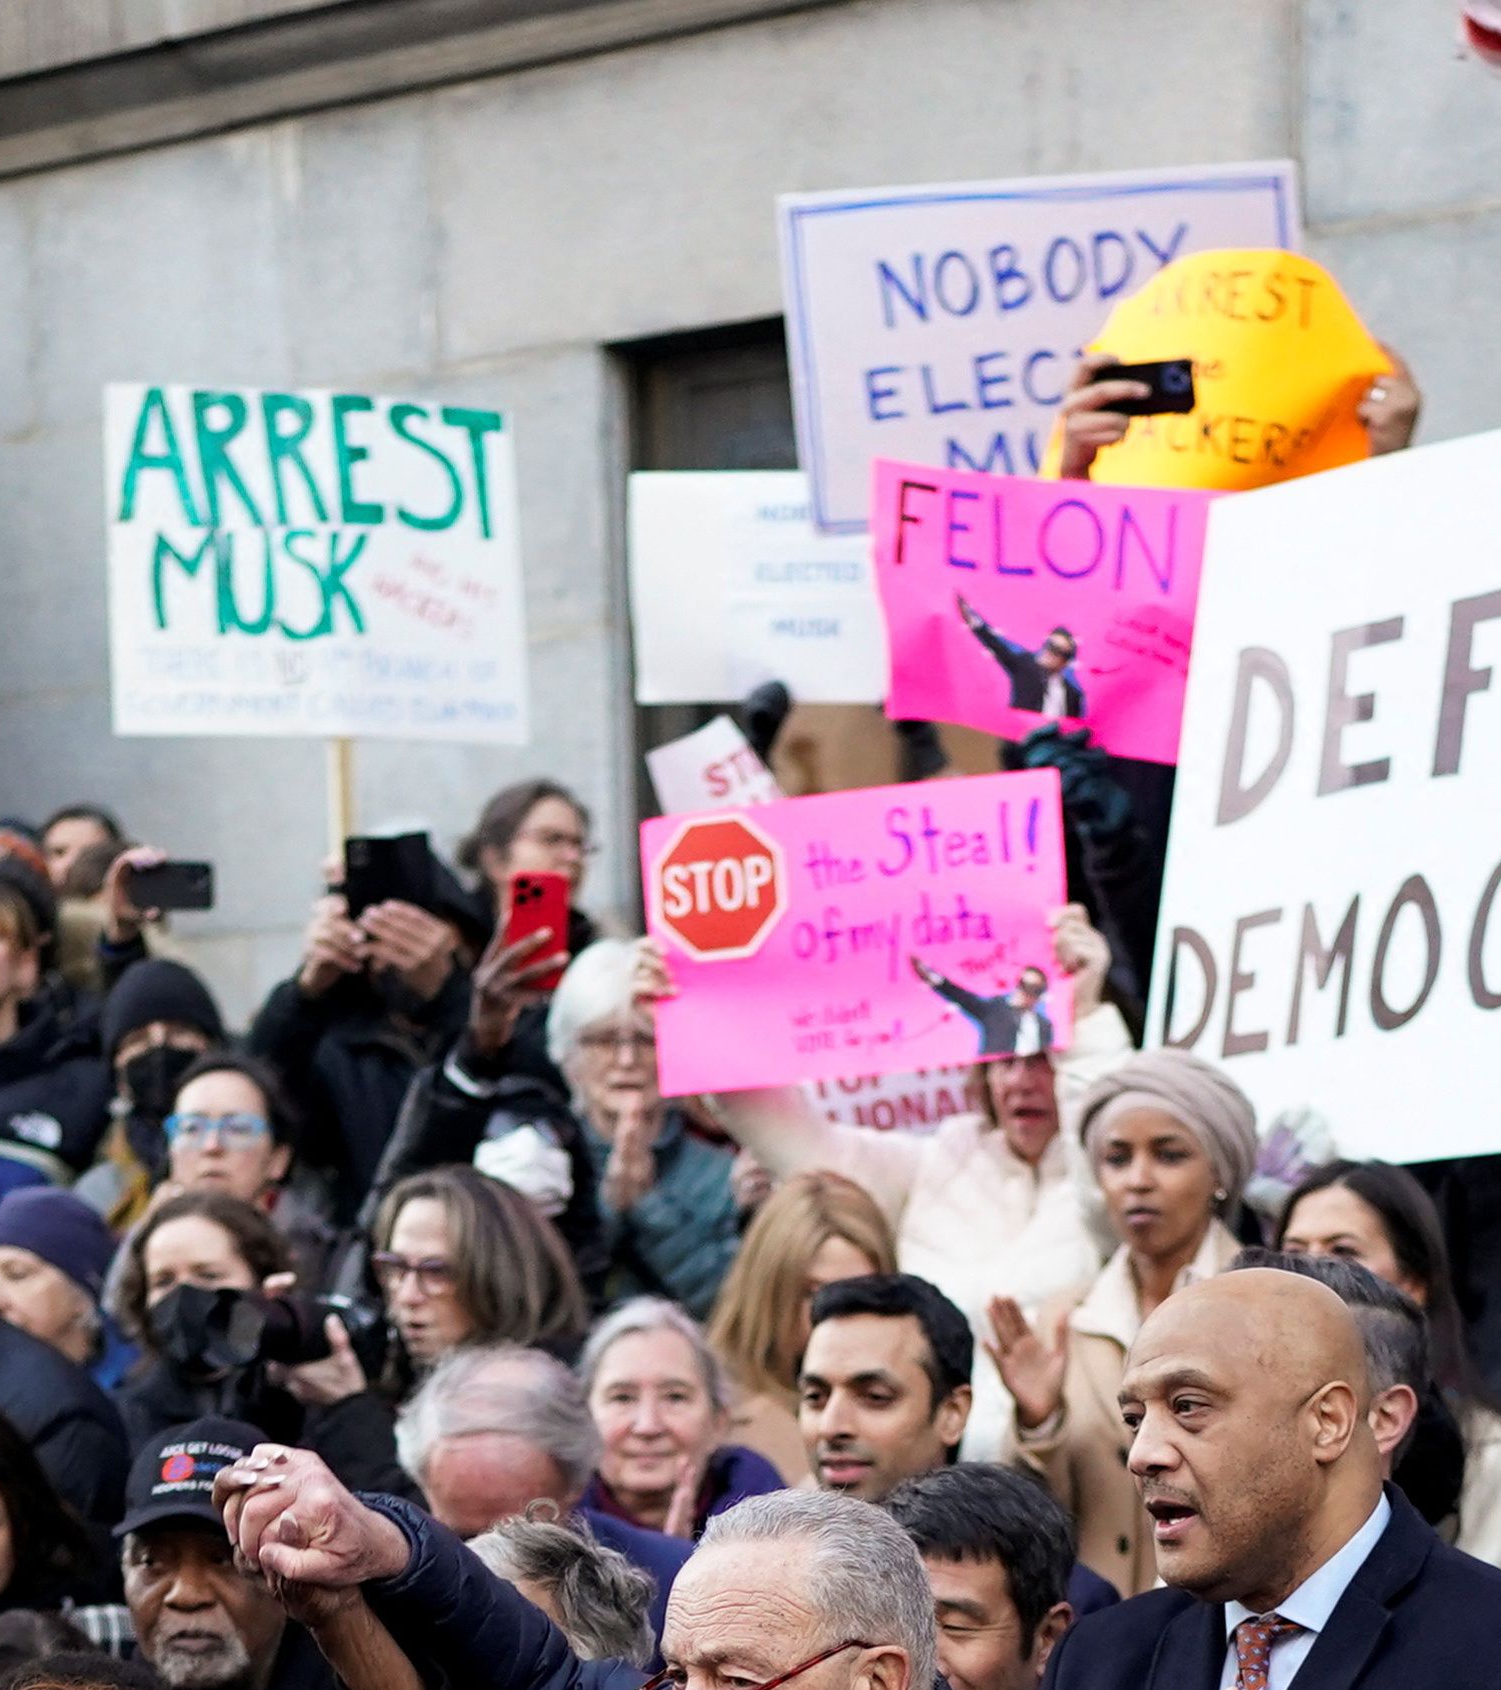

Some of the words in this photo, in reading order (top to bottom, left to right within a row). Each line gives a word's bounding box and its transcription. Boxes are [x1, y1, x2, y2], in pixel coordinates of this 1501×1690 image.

[877, 223, 1189, 328] NOBODY
[865, 348, 1085, 422] ELEC
[117, 386, 503, 541] ARREST
[152, 527, 369, 641] MUSK
[895, 480, 1177, 594] FELON
[662, 853, 774, 919] STOP
[804, 842, 867, 891] the
[876, 797, 1041, 878] Steal!
[912, 892, 994, 947] data
